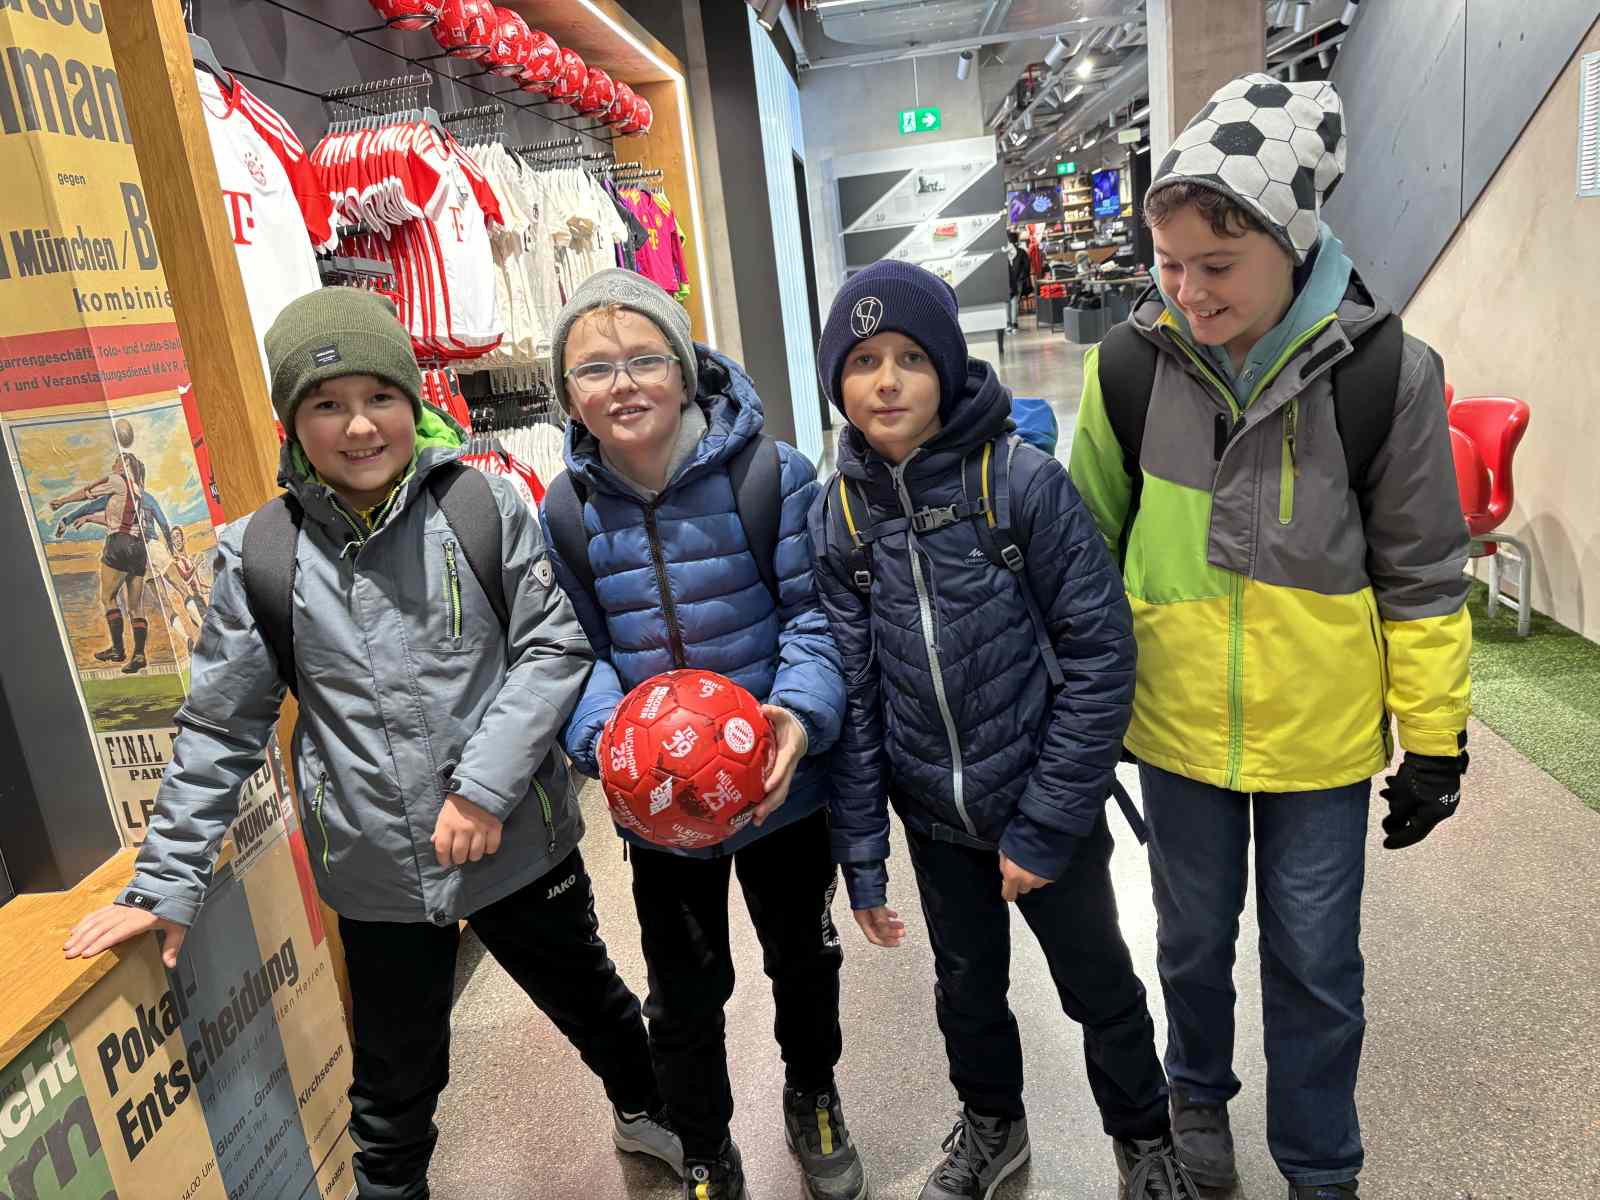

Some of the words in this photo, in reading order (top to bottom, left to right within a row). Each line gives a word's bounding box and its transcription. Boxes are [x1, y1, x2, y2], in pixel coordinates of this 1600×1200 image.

[57, 172, 86, 186] gegen
[9, 225, 119, 277] München
[105, 734, 163, 765] FINAL
[682, 725, 699, 745] TEL
[232, 792, 282, 854] MUNICH
[546, 874, 576, 900] JAKO
[116, 937, 299, 1163] Entscheidung
[0, 1037, 78, 1139] cht
